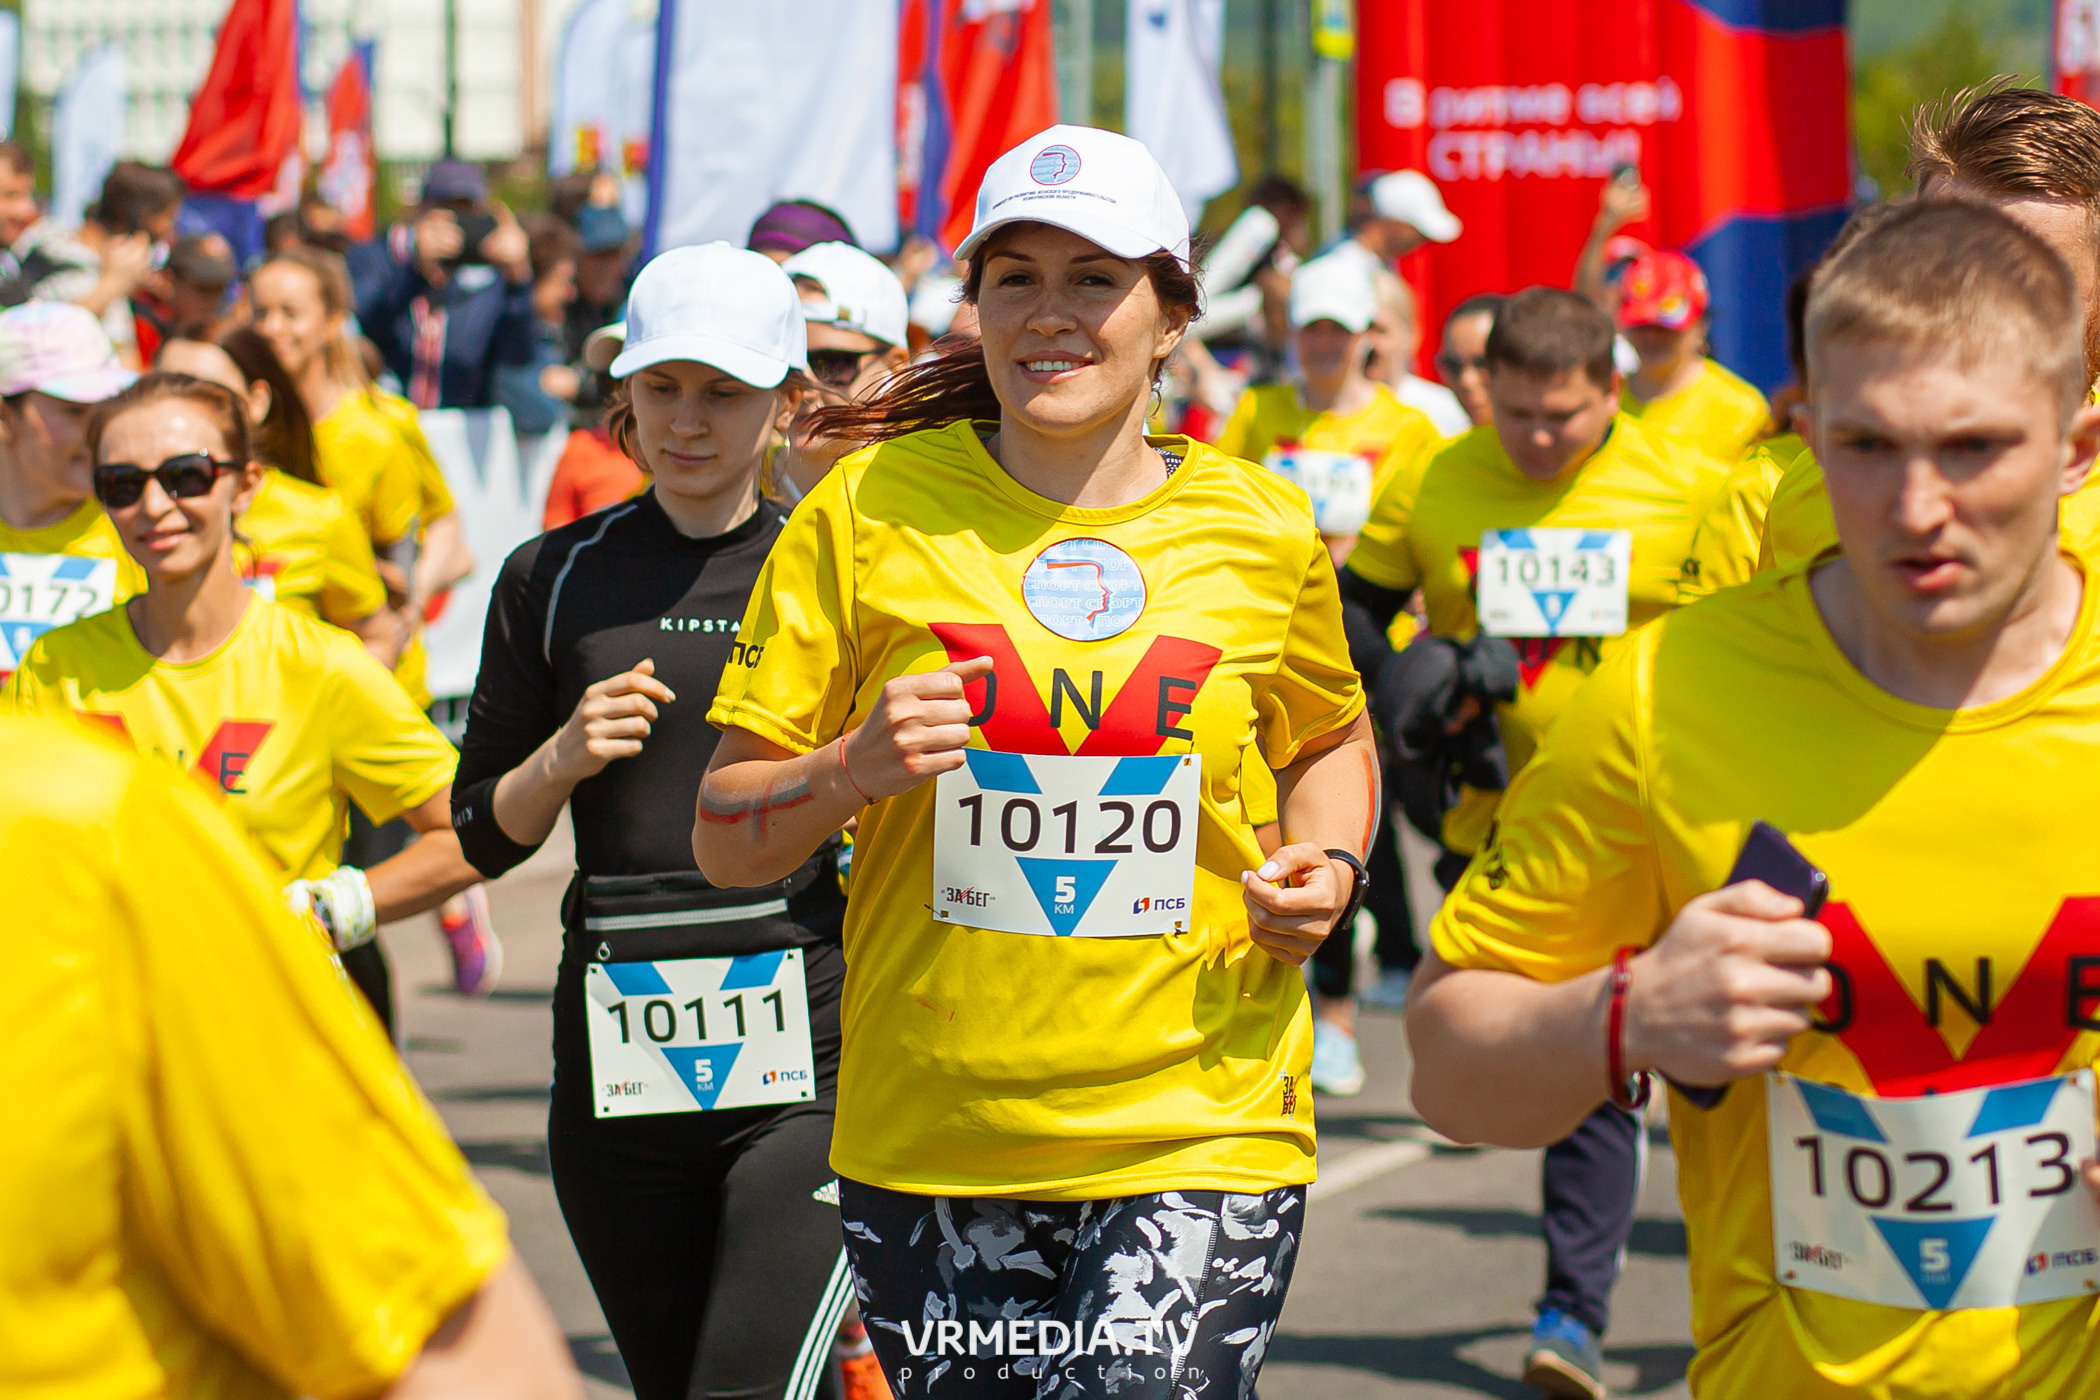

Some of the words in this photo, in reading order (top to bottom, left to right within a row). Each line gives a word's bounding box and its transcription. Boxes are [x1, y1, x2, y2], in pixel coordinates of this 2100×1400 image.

[1496, 553, 1616, 585] 10143
[660, 617, 741, 633] KIPSTA
[958, 793, 1181, 854] 10120
[1055, 876, 1077, 904] 5
[1154, 897, 1186, 911] ПСБ
[607, 988, 785, 1044] 10111
[694, 1059, 714, 1083] 5
[1795, 1131, 2077, 1212] 10213
[1919, 1238, 1951, 1272] 5
